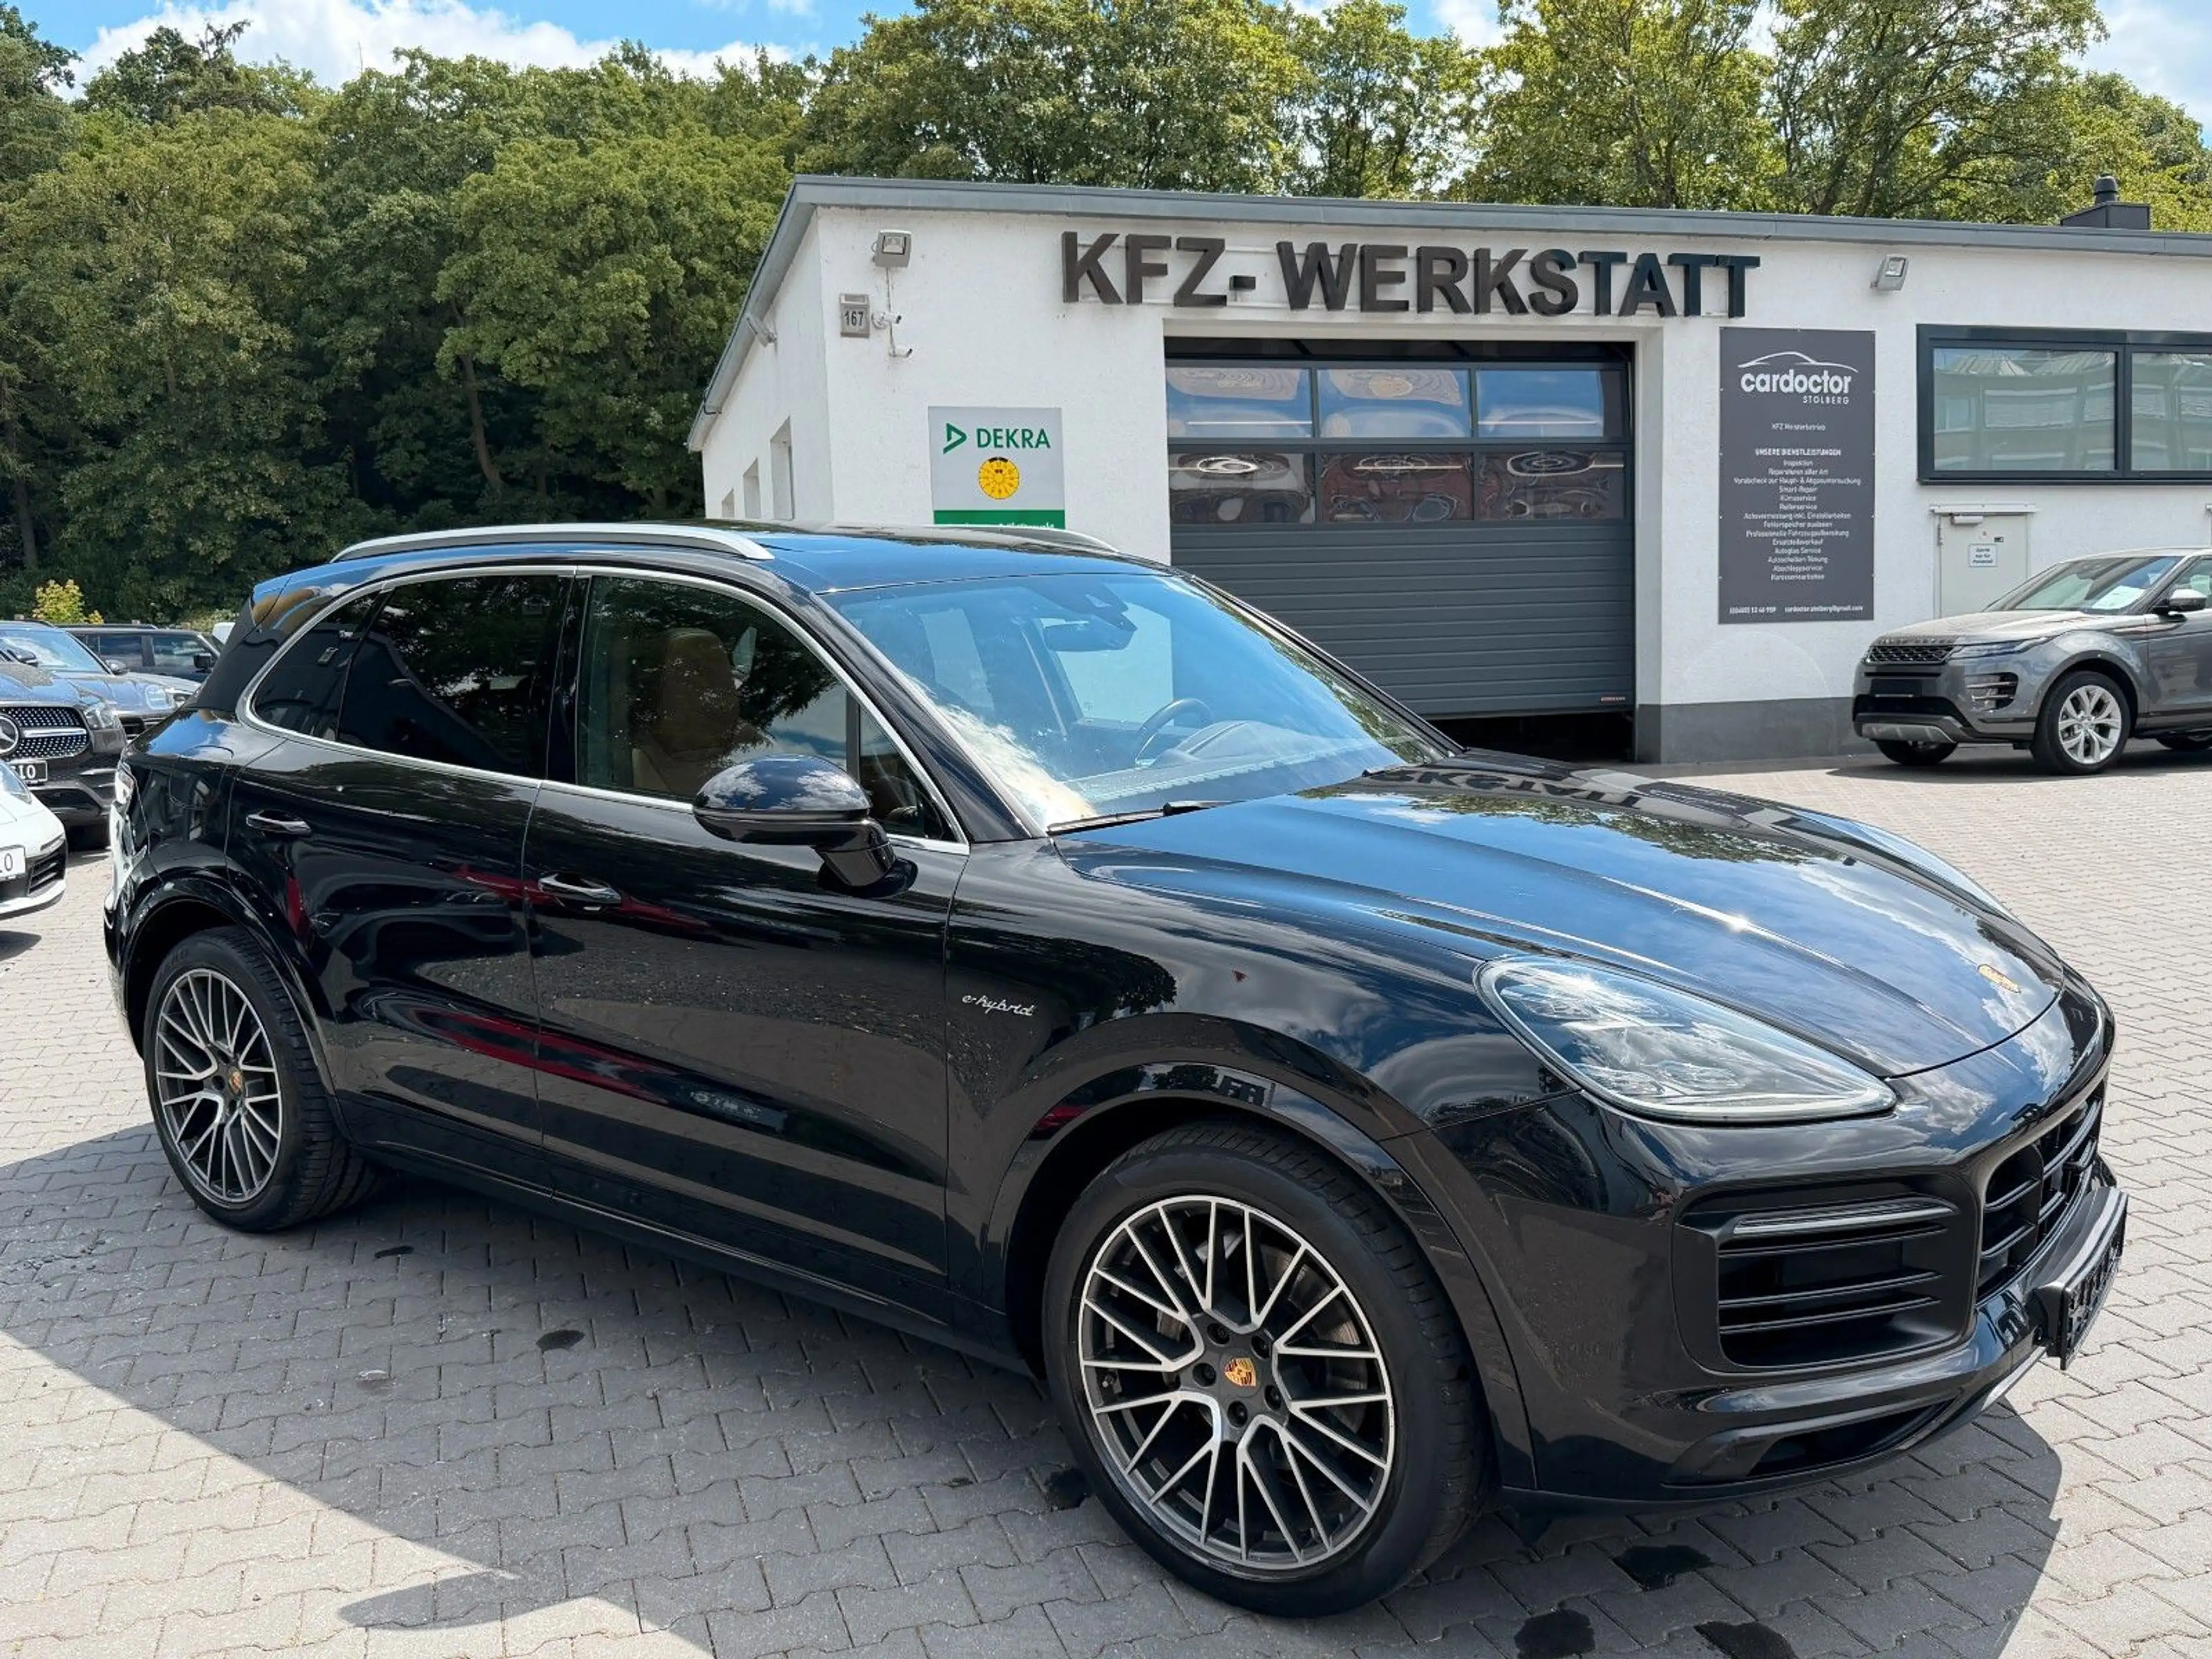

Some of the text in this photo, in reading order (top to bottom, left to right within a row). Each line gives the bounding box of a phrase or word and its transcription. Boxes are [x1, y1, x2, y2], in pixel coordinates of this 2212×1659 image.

[844, 310, 864, 326] 167
[1740, 369, 1852, 393] cardoctor
[1802, 395, 1850, 404] STOLBERG
[976, 428, 1051, 449] DEKRA
[961, 995, 1036, 1017] e-hybrid
